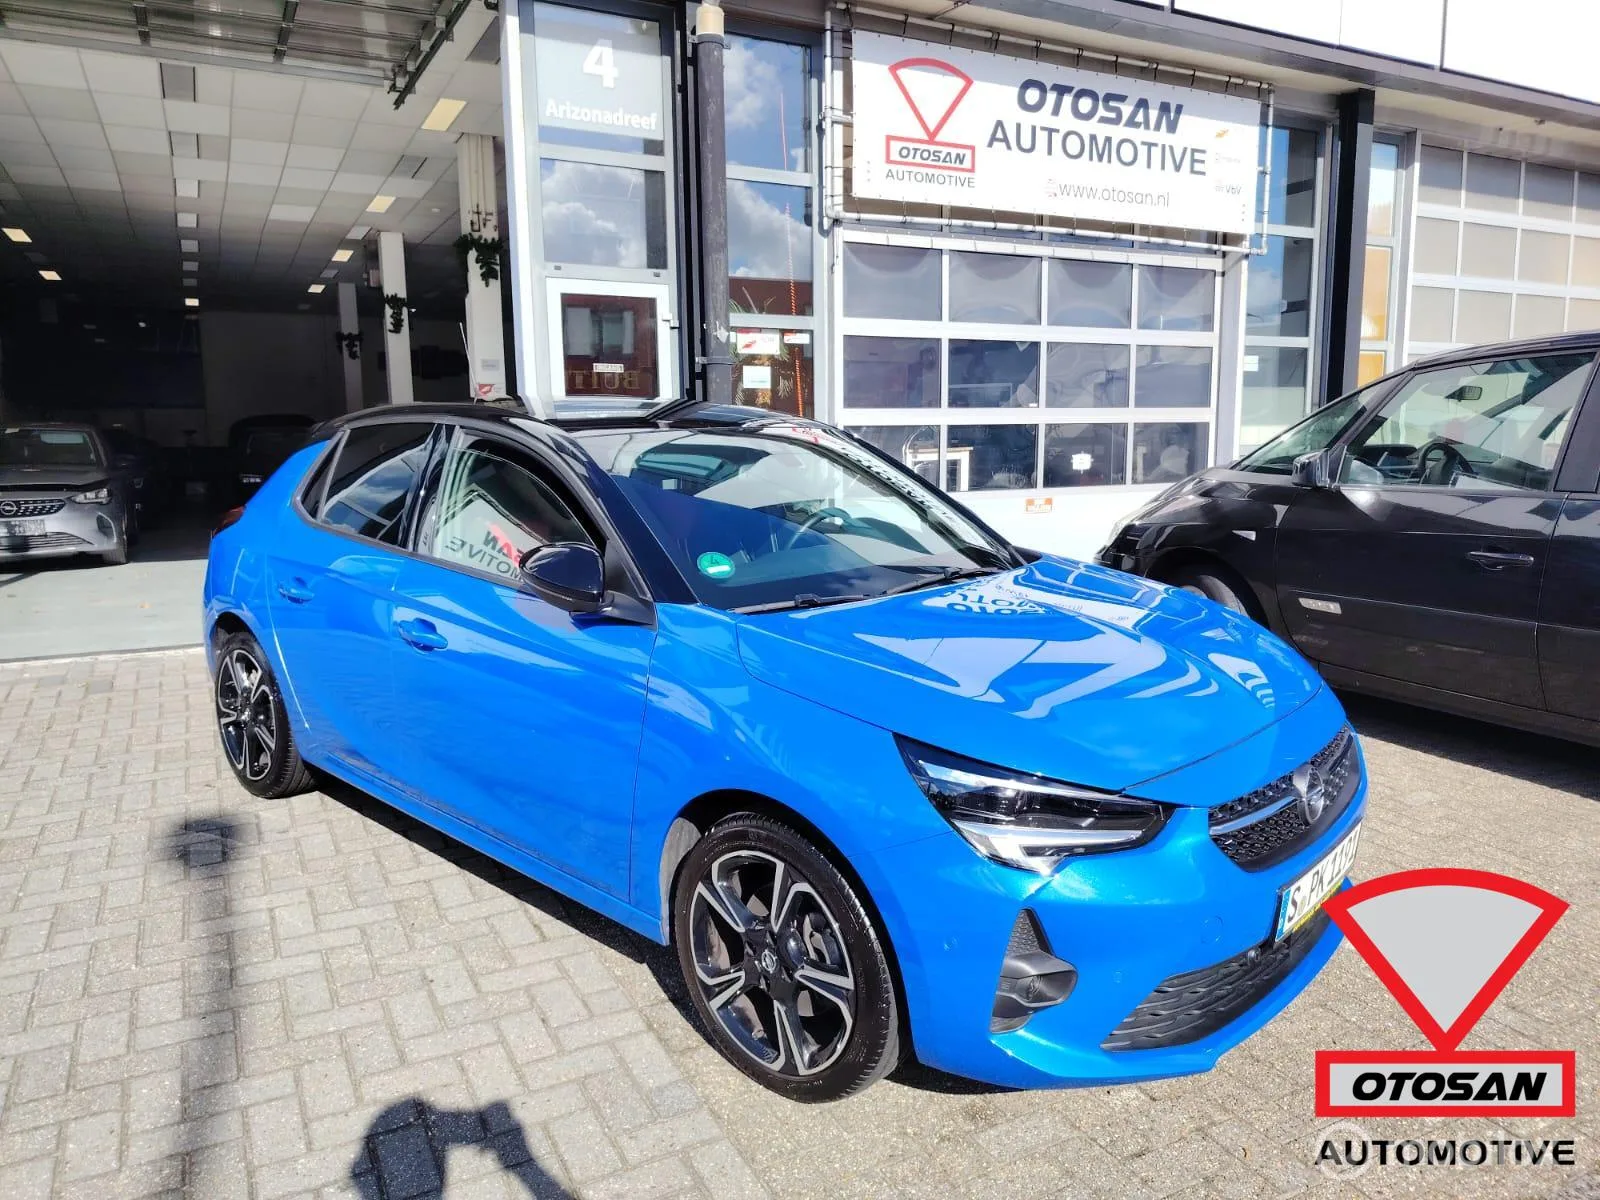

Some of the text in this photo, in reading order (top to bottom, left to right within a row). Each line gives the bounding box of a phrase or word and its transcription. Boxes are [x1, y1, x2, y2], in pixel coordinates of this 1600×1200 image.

[582, 38, 619, 89] 4
[545, 98, 658, 130] Arizonadreef
[1016, 77, 1185, 134] OTOSAN
[898, 145, 967, 166] OTOSAN
[986, 119, 1208, 176] AUTOMOTIVE
[885, 168, 976, 188] AUTOMOTIVE
[1058, 181, 1170, 208] www.otosan.nl
[1287, 885, 1301, 923] S
[1307, 859, 1330, 906] PK
